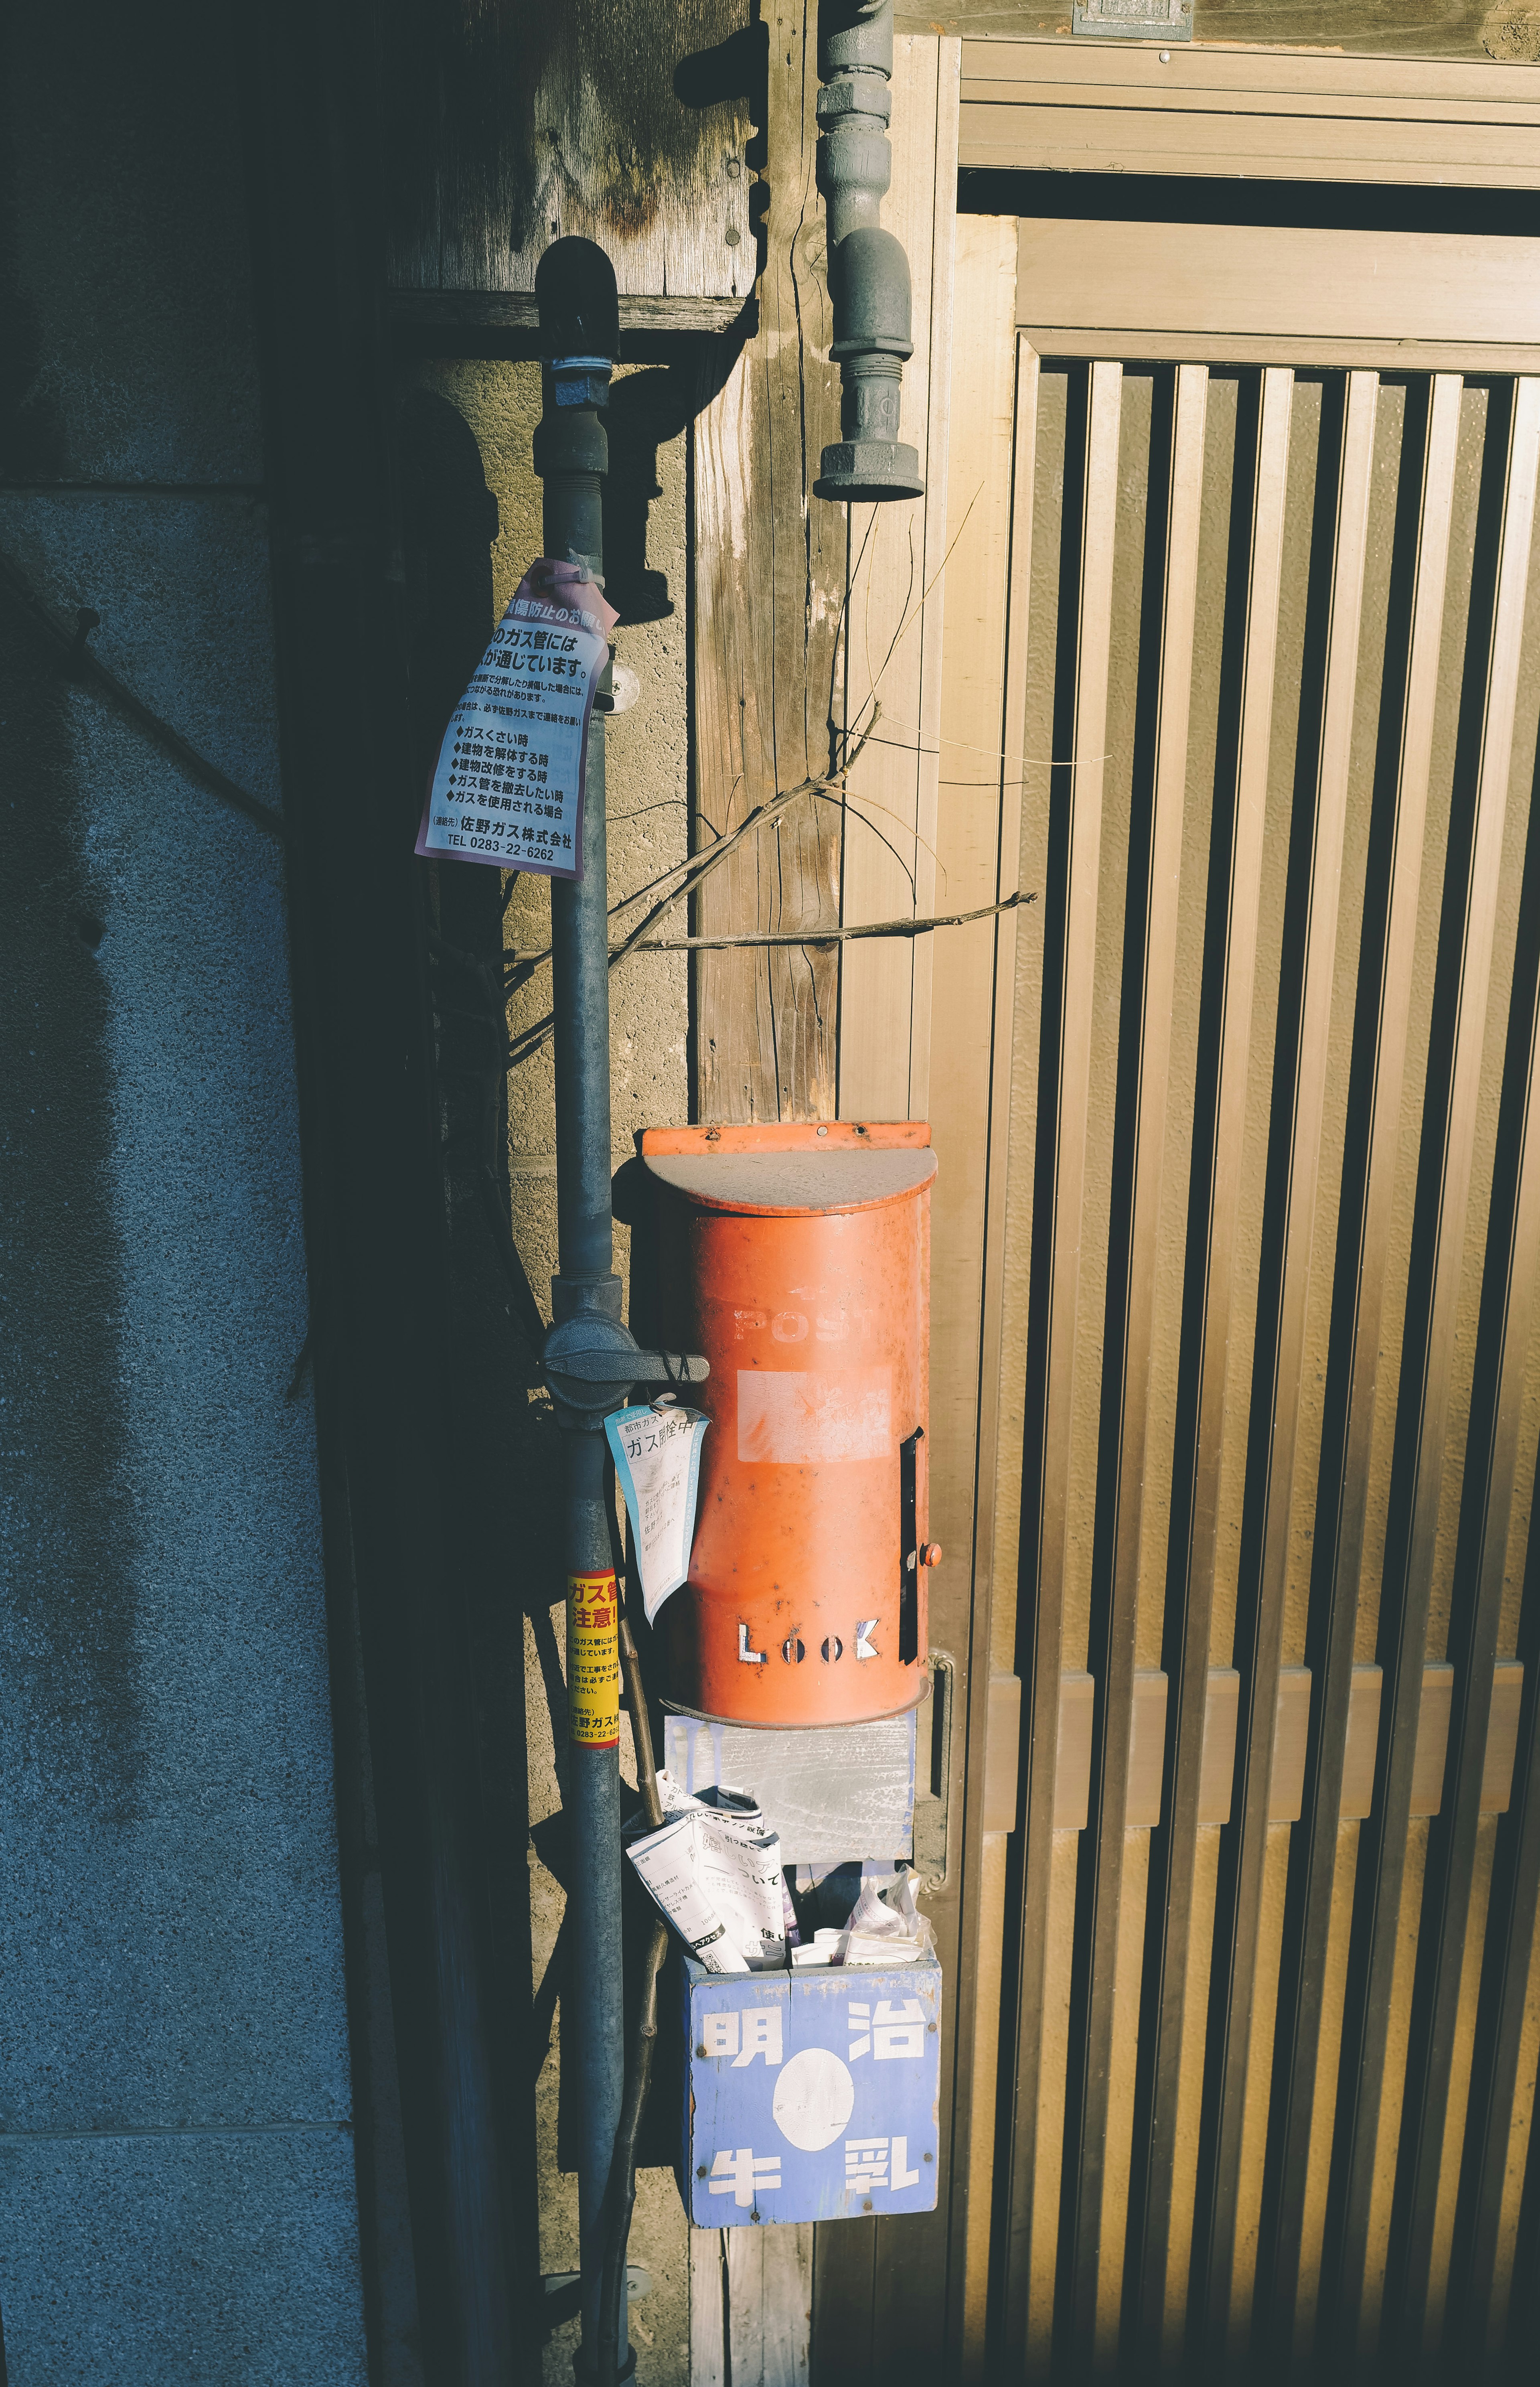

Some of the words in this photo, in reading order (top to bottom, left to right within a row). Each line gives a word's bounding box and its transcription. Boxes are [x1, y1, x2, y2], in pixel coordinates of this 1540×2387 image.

[492, 627, 578, 652] のガス管には
[481, 649, 586, 679] が通じています。
[471, 674, 584, 697] を無断で分解したり損傷した場合には、
[464, 726, 529, 747] ガスくさい時
[461, 742, 549, 767] 建物を解体する時
[459, 758, 548, 784] 建物改修をする時
[457, 775, 564, 803] ガス管を撤去したい時
[455, 791, 563, 820] ガスを使用される場合
[461, 815, 572, 850] 佐野ガス株式会社
[448, 834, 466, 846] TEL
[470, 837, 554, 861] 0283-22-6262
[624, 1416, 659, 1434] 都市ガス
[627, 1420, 694, 1458] ガス閉栓中
[739, 1619, 879, 1665] LOOK
[667, 1794, 675, 1802] 鉄
[660, 1881, 696, 1903] ンサーライトカメラ
[703, 1999, 927, 2067] 明治
[709, 2136, 919, 2208] 牛乳
